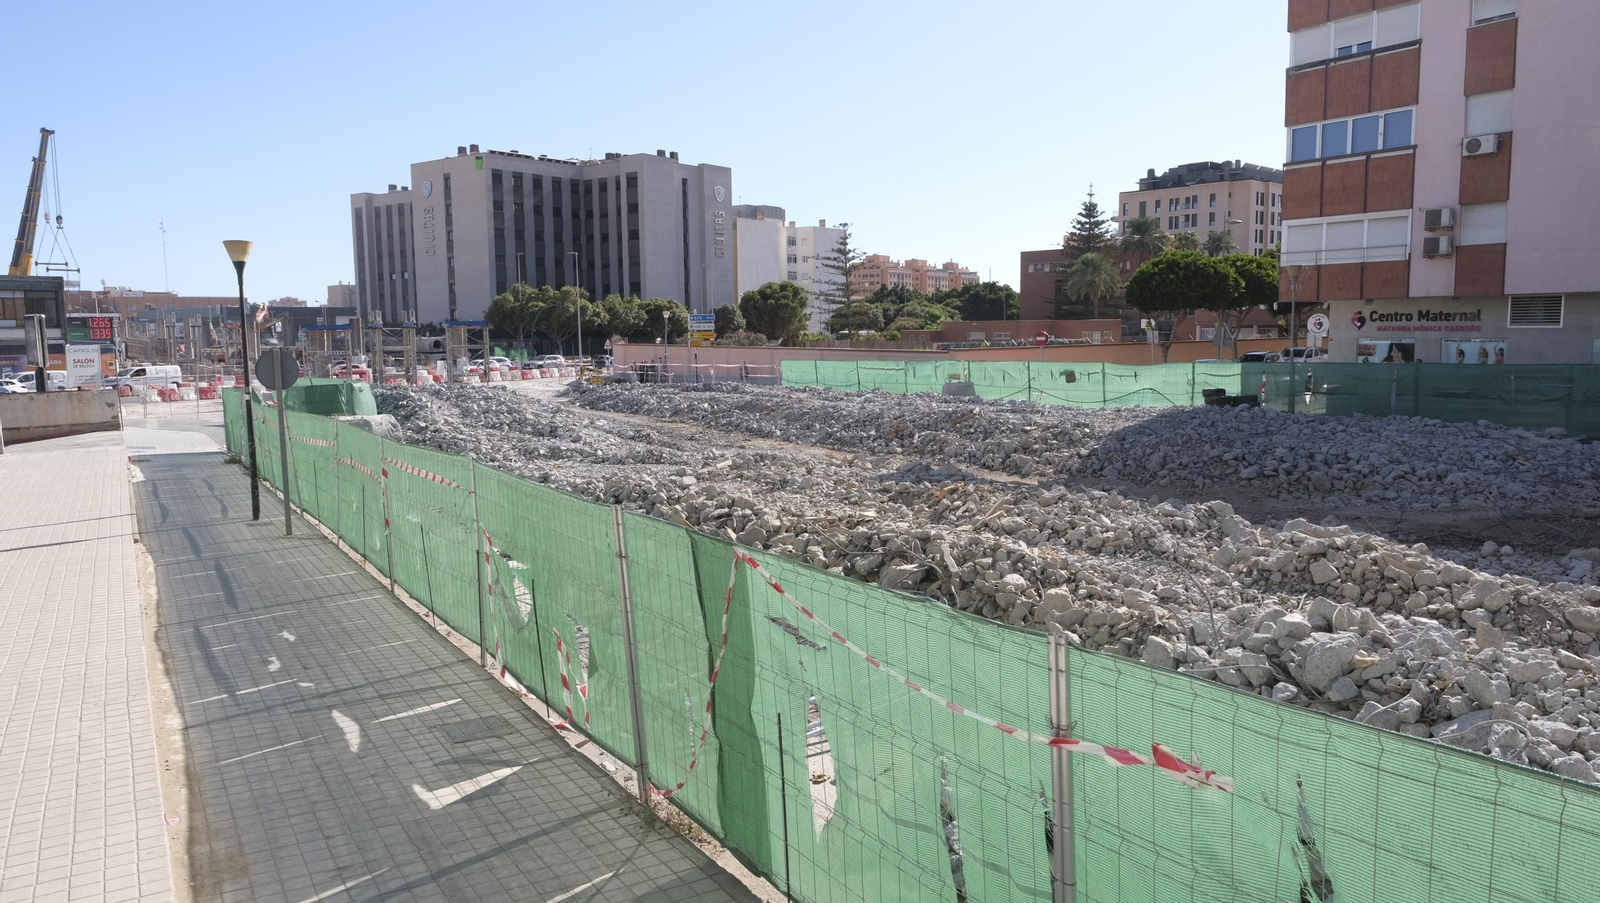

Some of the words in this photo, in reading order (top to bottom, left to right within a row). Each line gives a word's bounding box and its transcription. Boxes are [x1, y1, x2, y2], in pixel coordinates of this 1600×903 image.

[1369, 310, 1414, 322] Centro
[1417, 308, 1482, 322] Maternal
[1413, 324, 1443, 332] MÓNICA
